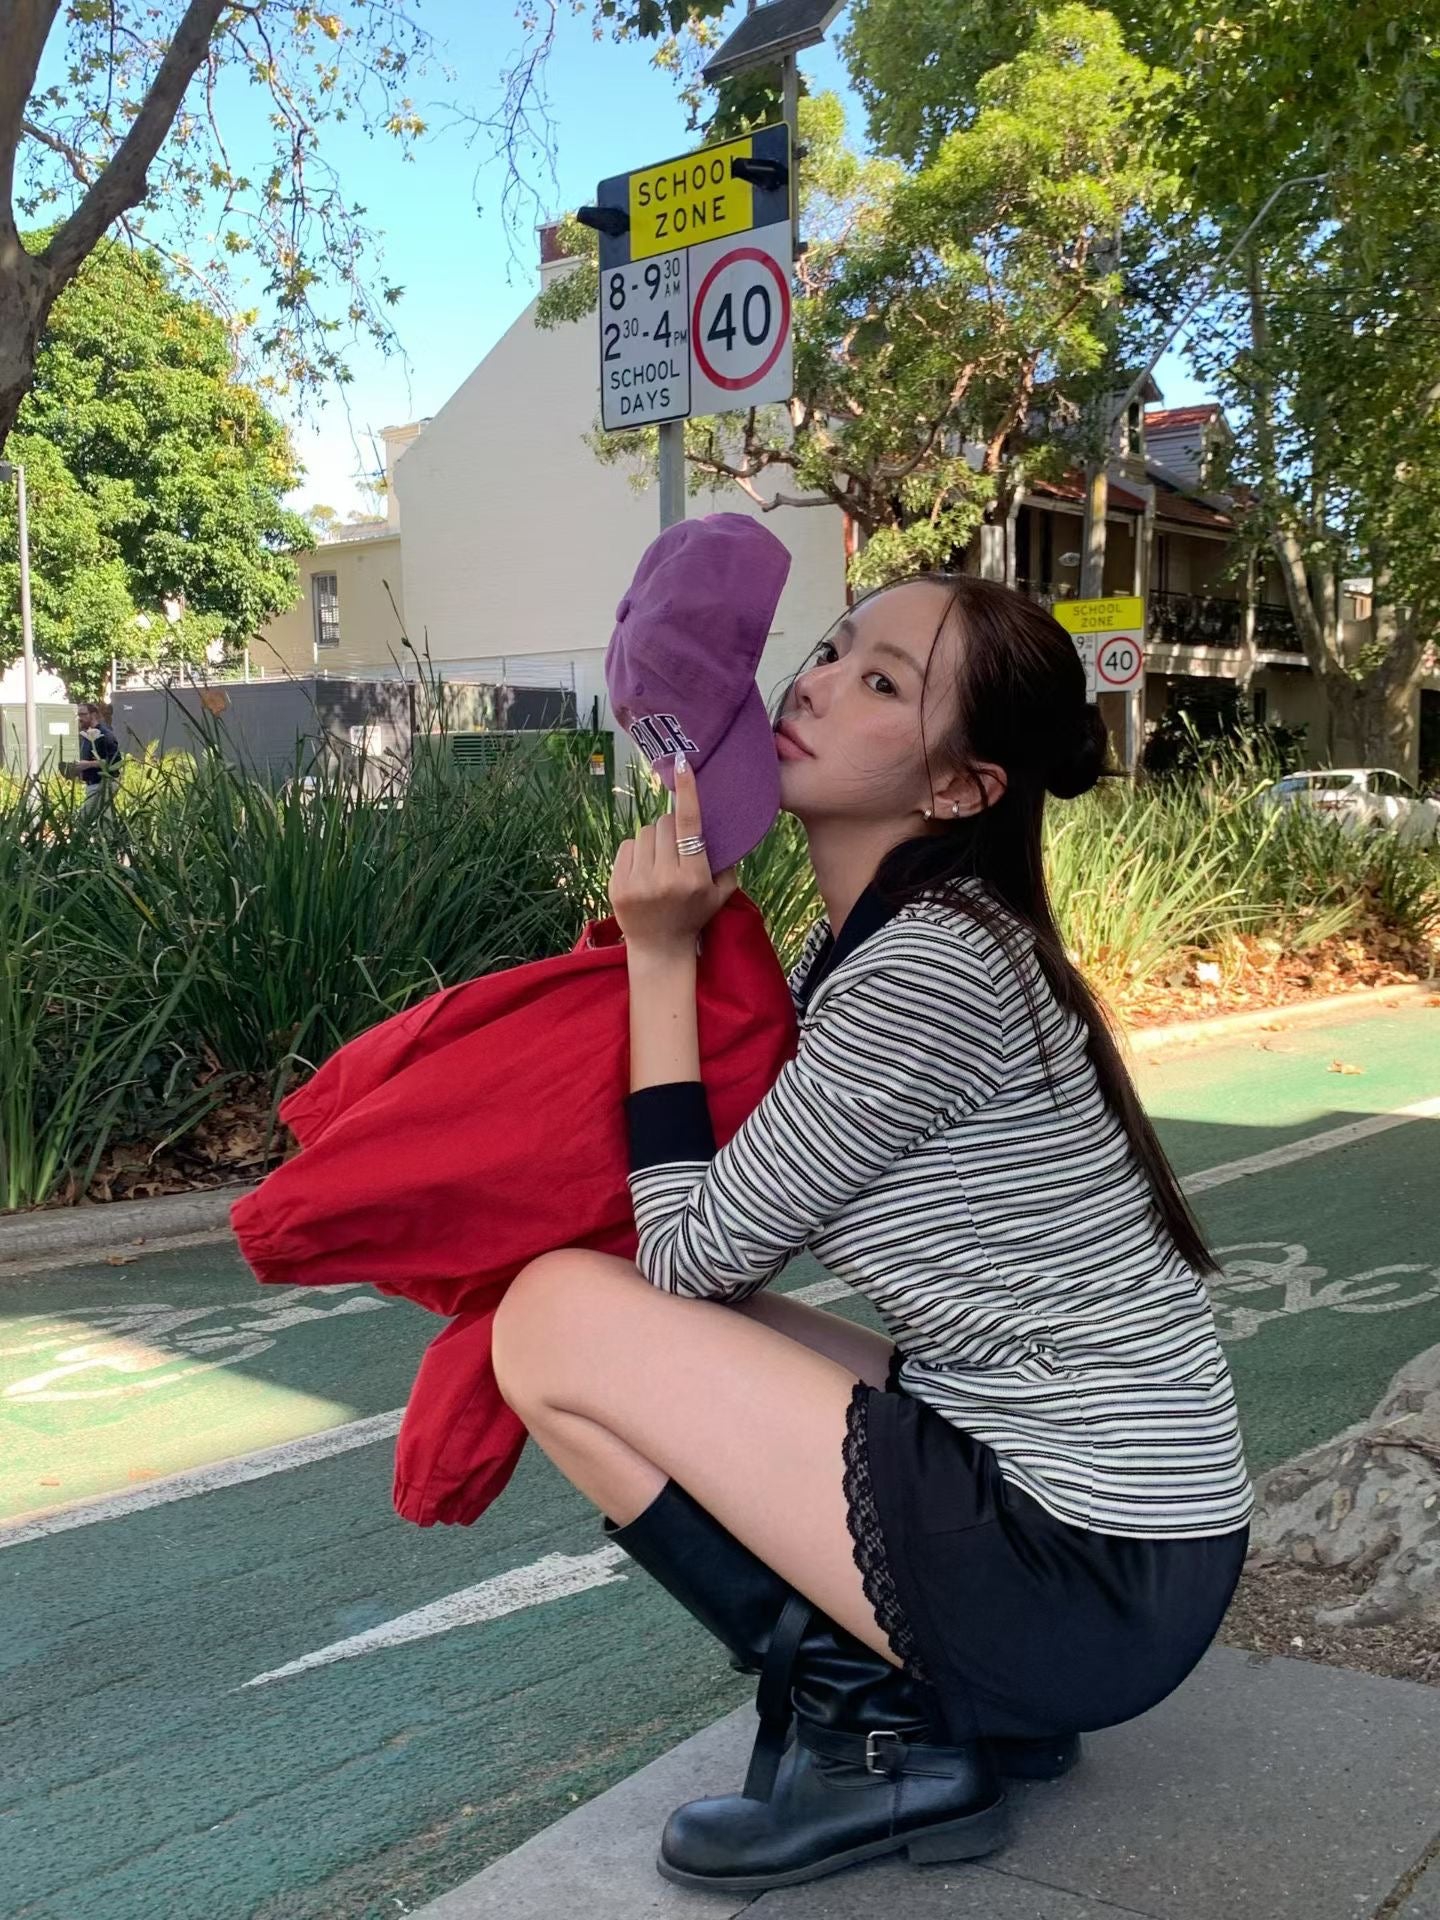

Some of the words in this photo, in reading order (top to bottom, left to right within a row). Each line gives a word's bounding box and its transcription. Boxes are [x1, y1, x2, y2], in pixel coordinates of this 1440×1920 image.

[655, 195, 726, 238] ZONE
[707, 284, 771, 351] 40
[610, 359, 680, 390] SCHOOL
[620, 387, 671, 416] DAYS
[1073, 603, 1123, 616] SCHOOL
[1081, 616, 1114, 628] ZONE
[1105, 650, 1133, 671] 40
